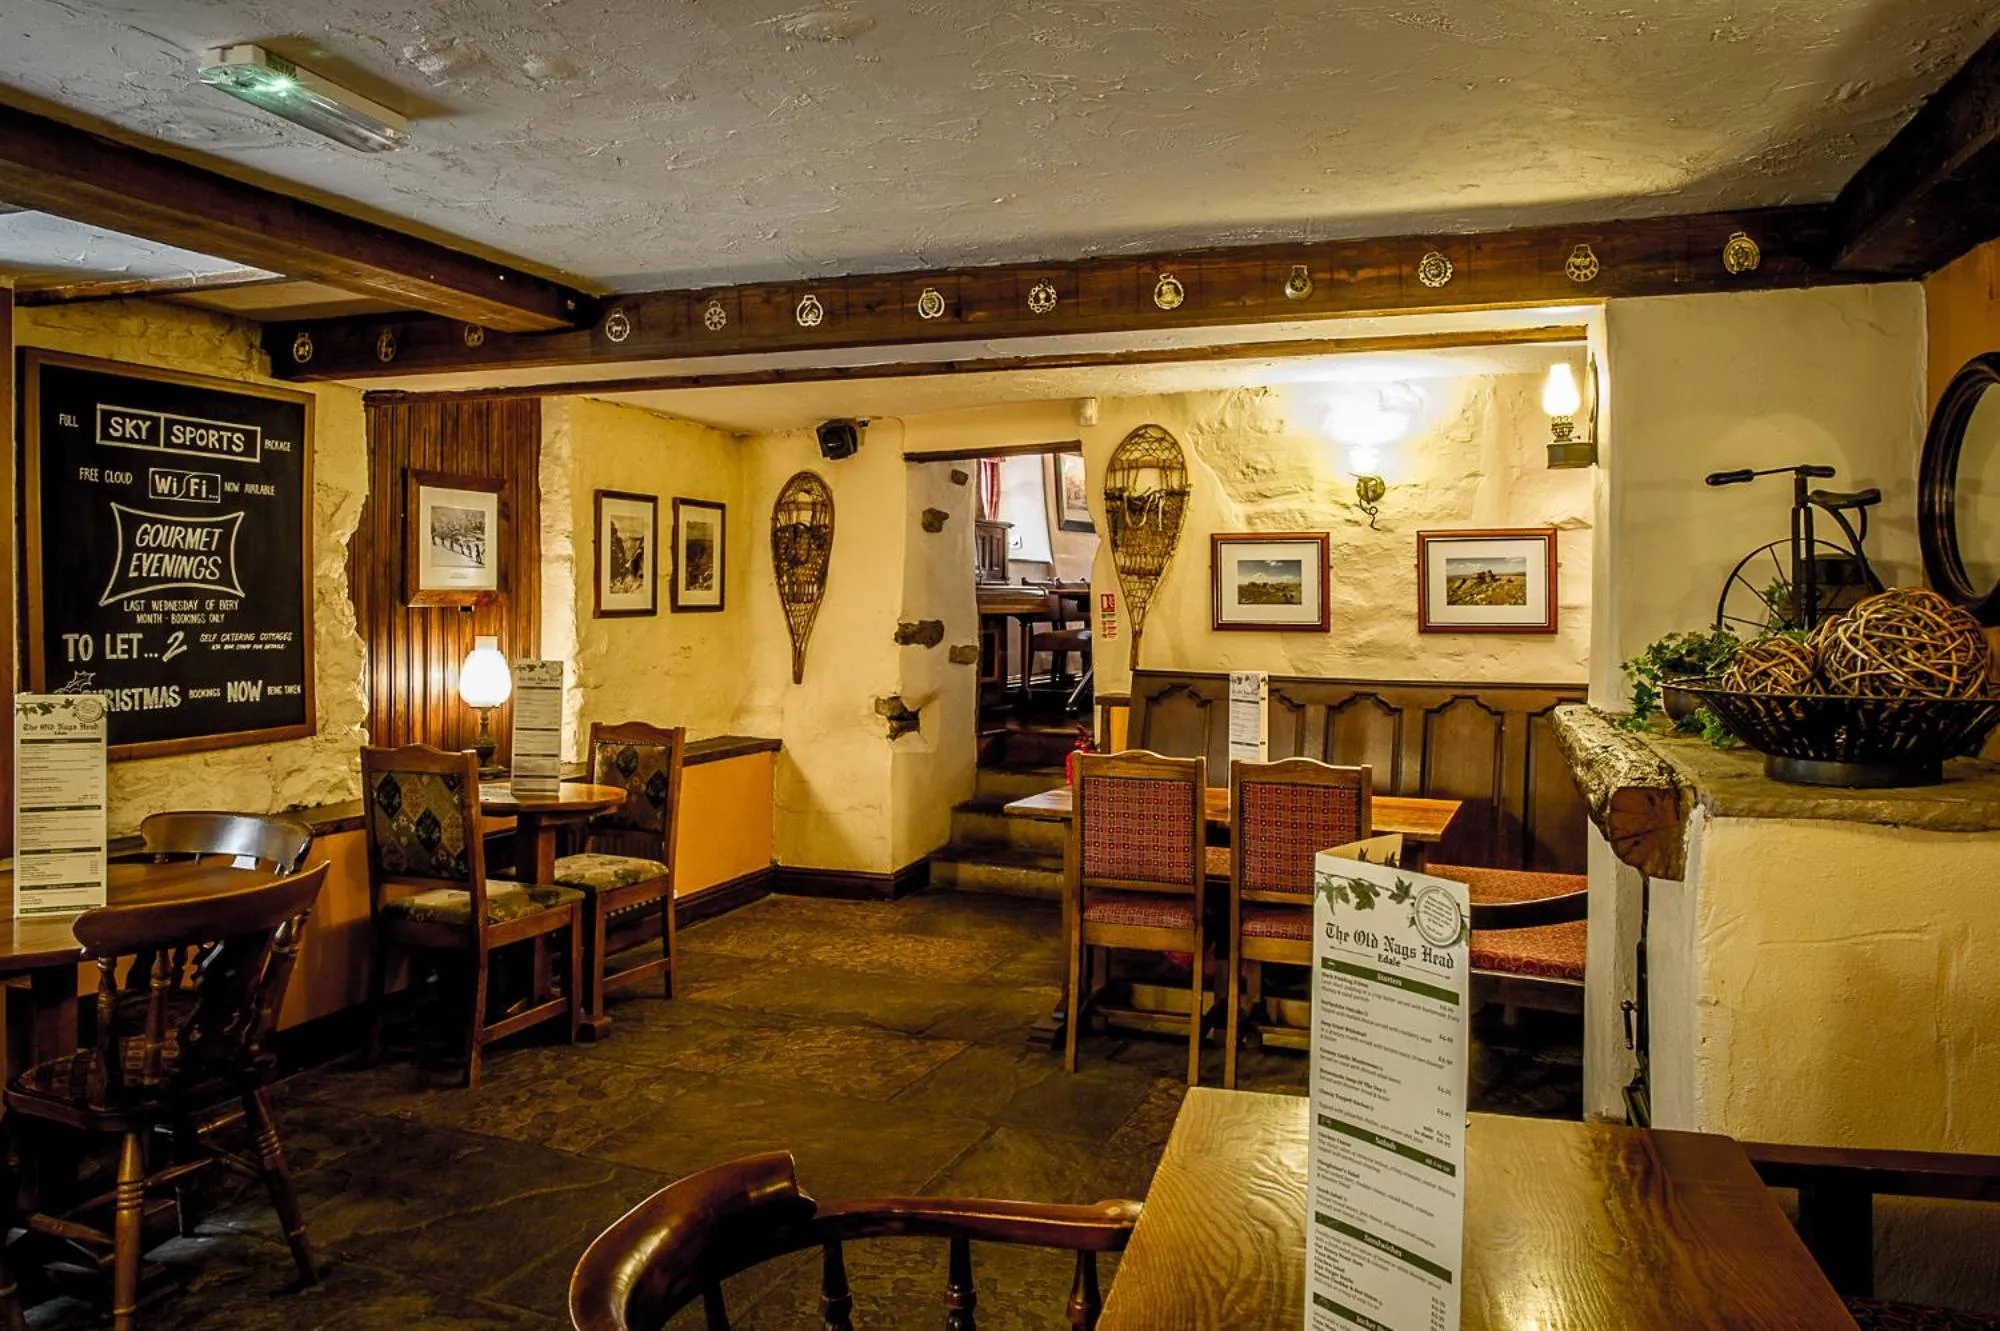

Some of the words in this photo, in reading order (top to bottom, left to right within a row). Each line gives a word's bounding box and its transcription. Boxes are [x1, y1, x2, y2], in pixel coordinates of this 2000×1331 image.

[59, 413, 79, 427] FULL
[108, 416, 152, 439] SKY
[170, 425, 245, 452] SPORTS
[264, 439, 292, 452] PACKAGE
[79, 467, 99, 482] FREE
[104, 470, 133, 484] CLOUD
[224, 482, 241, 492] NOW
[244, 483, 276, 496] AVAILABLE
[135, 523, 224, 552] GOURMET
[128, 552, 223, 580] EVENINGS
[123, 600, 145, 612] LAST
[151, 600, 198, 611] WEDNESDAY
[205, 600, 215, 610] OF
[219, 600, 239, 610] EVERY
[136, 613, 163, 624] MONTH
[171, 613, 206, 624] BOOKINGS
[209, 613, 225, 623] ONLY
[62, 633, 94, 662] TO
[162, 630, 188, 662] 2
[200, 633, 218, 642] SELF
[220, 632, 256, 642] CATERING
[259, 632, 293, 642] COTTAGES
[188, 688, 221, 699] BOOKINGS
[226, 680, 263, 703] NOW
[1325, 922, 1351, 945] The
[1353, 929, 1379, 949] Old
[1383, 935, 1417, 961] Nags
[1421, 944, 1455, 970] Head
[1377, 953, 1401, 968] Edale
